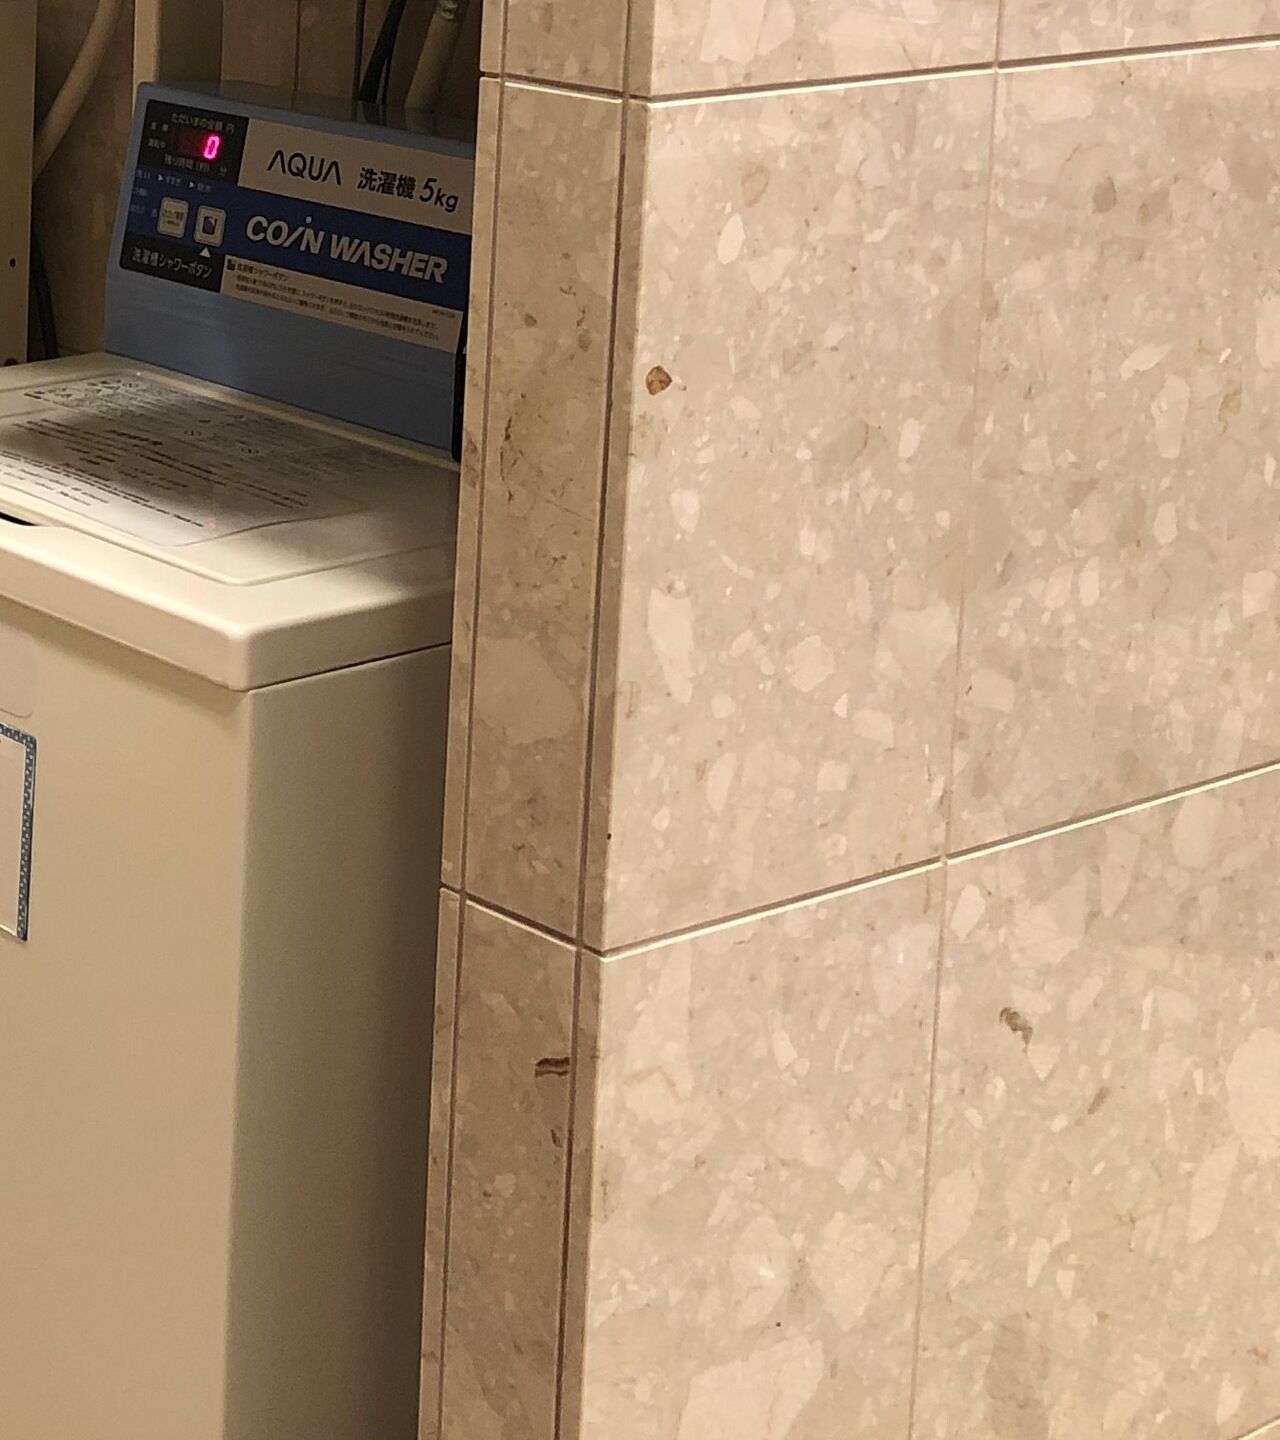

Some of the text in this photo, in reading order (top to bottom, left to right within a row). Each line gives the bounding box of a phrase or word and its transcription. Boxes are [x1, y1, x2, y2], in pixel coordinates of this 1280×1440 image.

[203, 134, 222, 160] 0
[266, 149, 342, 186] AQUA
[356, 167, 460, 213] 洗濯機 5kg
[329, 232, 449, 284] WASHER
